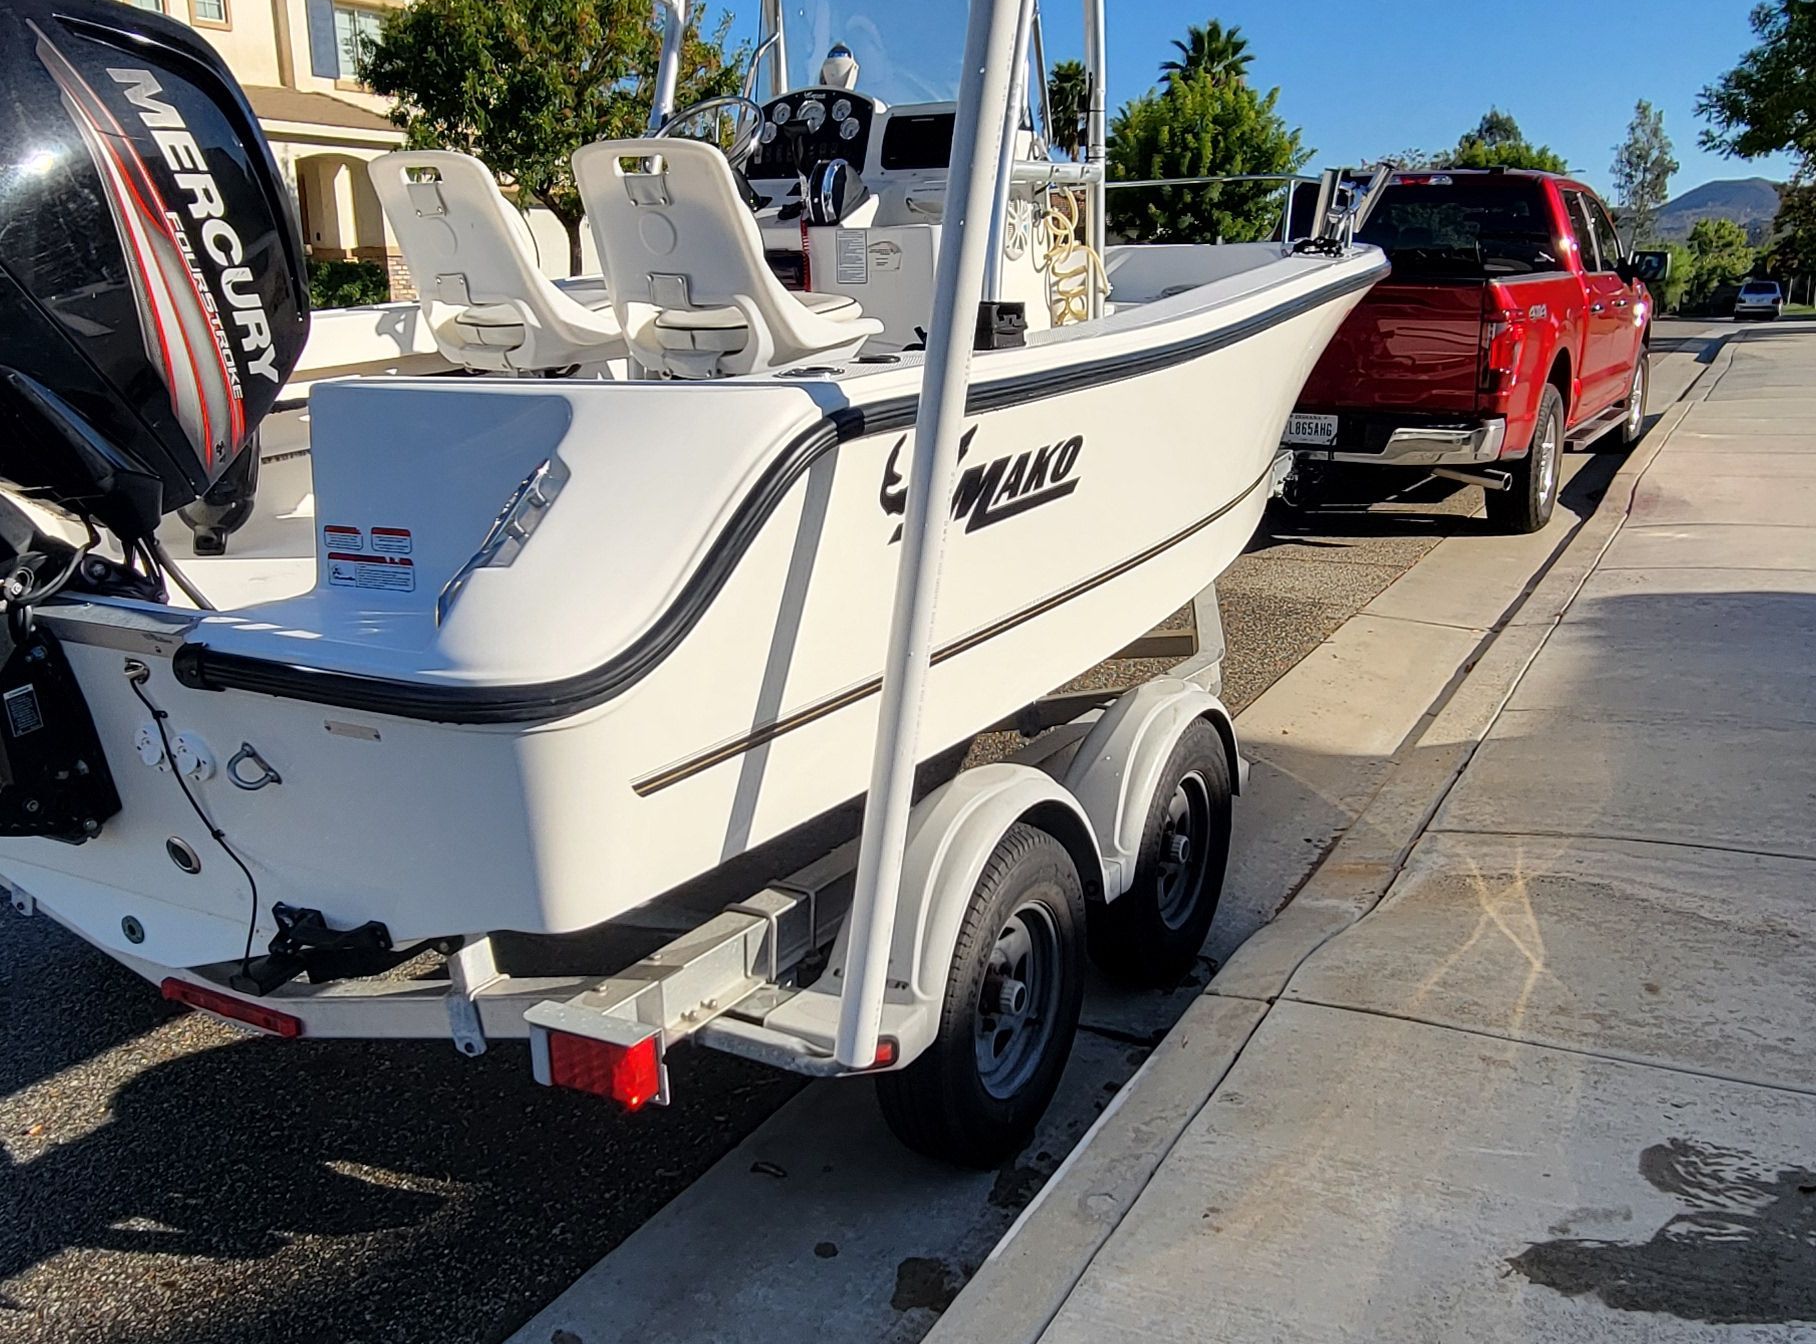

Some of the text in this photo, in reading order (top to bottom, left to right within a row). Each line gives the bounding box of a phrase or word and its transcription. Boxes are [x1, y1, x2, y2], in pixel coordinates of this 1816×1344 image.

[105, 68, 279, 383] MERCURY
[165, 210, 244, 400] FOURSTROKE
[949, 435, 1083, 534] MAKO
